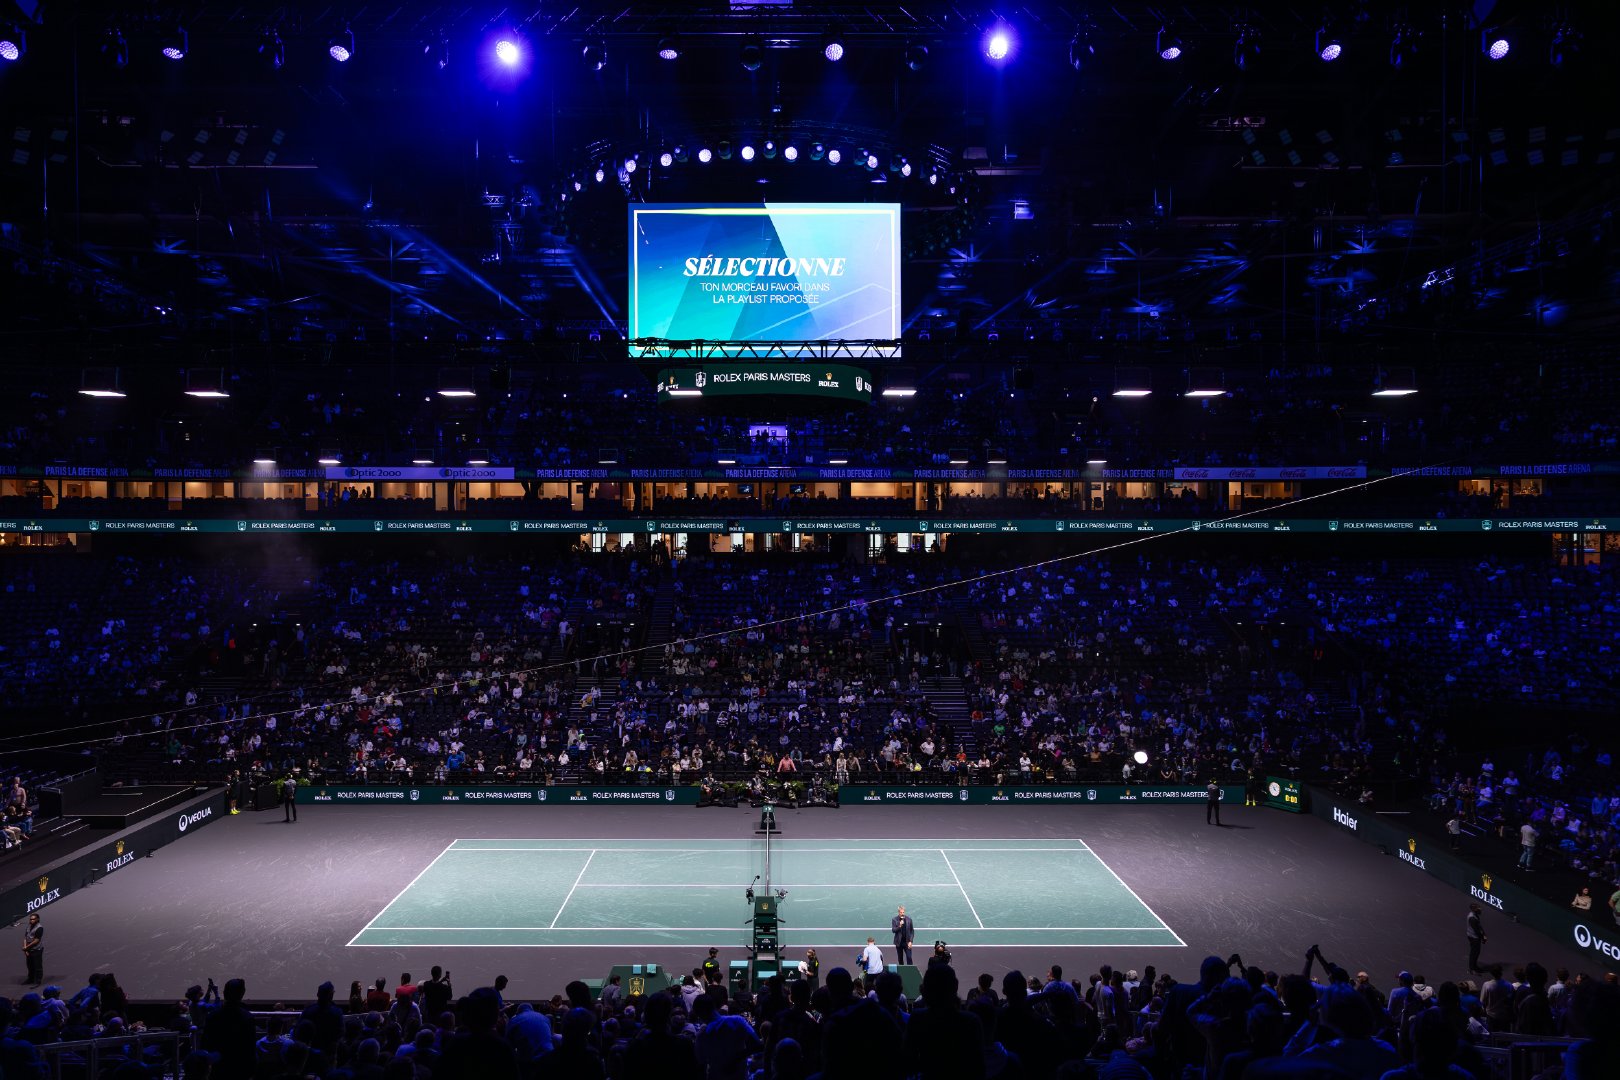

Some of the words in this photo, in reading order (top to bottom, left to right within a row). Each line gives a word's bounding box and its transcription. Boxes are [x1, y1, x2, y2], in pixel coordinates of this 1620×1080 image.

[683, 254, 846, 277] SÉLECTIONNE
[700, 282, 720, 292] TON
[721, 282, 769, 292] MORCEAU
[770, 282, 802, 292] FAVORI
[804, 282, 830, 292] DANS
[713, 294, 725, 304] LA
[727, 294, 768, 304] PLAYLIST
[770, 293, 819, 304] PROPOSÉE
[713, 374, 741, 383] ROLEX
[743, 373, 768, 381] PARIS
[770, 373, 811, 382] MASTERS
[818, 380, 839, 388] ROLEX
[45, 466, 66, 477] PARIS
[68, 466, 77, 477] LA
[78, 466, 108, 477] DEFENSE
[351, 468, 376, 479] Optic
[445, 468, 471, 479] Optic
[536, 469, 554, 478] PARIS
[555, 469, 563, 478] LA
[563, 469, 590, 478] DEFENSE
[631, 469, 649, 478] PARIS
[649, 469, 658, 478] LA
[658, 469, 685, 478] DEFENSE
[725, 469, 743, 478] PARIS
[744, 469, 752, 478] LA
[752, 469, 779, 478] DEFENSE
[819, 469, 838, 478] PARIS
[838, 469, 846, 478] LA
[846, 469, 873, 478] DEFENSE
[913, 469, 932, 478] PARIS
[932, 469, 940, 478] LA
[941, 469, 968, 478] DEFENSE
[1008, 469, 1026, 478] PARIS
[1027, 469, 1035, 478] LA
[1035, 469, 1062, 478] DEFENSE
[1102, 469, 1120, 478] PARIS
[1121, 469, 1129, 478] LA
[1130, 469, 1156, 478] DEFENSE
[1500, 464, 1522, 475] PARIS
[1523, 464, 1533, 475] LA
[1533, 464, 1568, 475] DEFENSE
[1568, 464, 1591, 475] ARENA
[188, 806, 212, 825] VEOLIA
[1333, 806, 1358, 831] Haier
[106, 851, 134, 872] ROLEX
[1399, 848, 1426, 870] ROLEX
[26, 887, 60, 913] ROLEX
[1470, 884, 1504, 911] ROLEX
[1592, 935, 1620, 961] VEO
